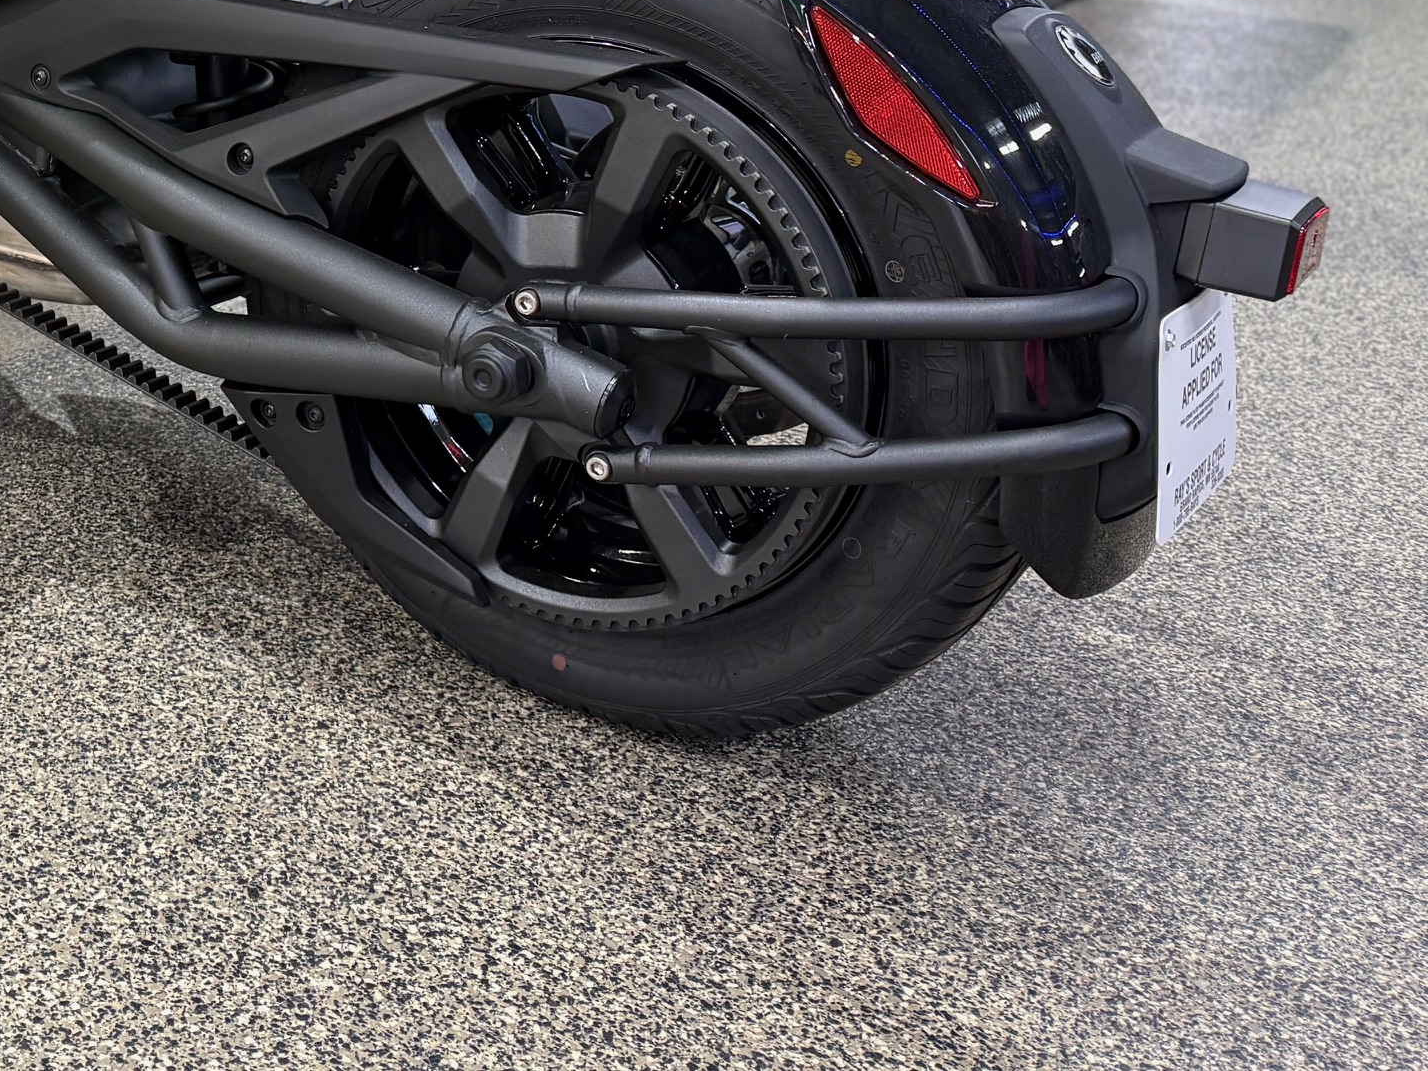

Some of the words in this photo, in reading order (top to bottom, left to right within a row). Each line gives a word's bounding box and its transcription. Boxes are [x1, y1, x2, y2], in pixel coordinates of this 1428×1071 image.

[1190, 326, 1216, 368] LICENSE
[1181, 366, 1210, 409] APPLIED
[1211, 352, 1223, 382] FOR
